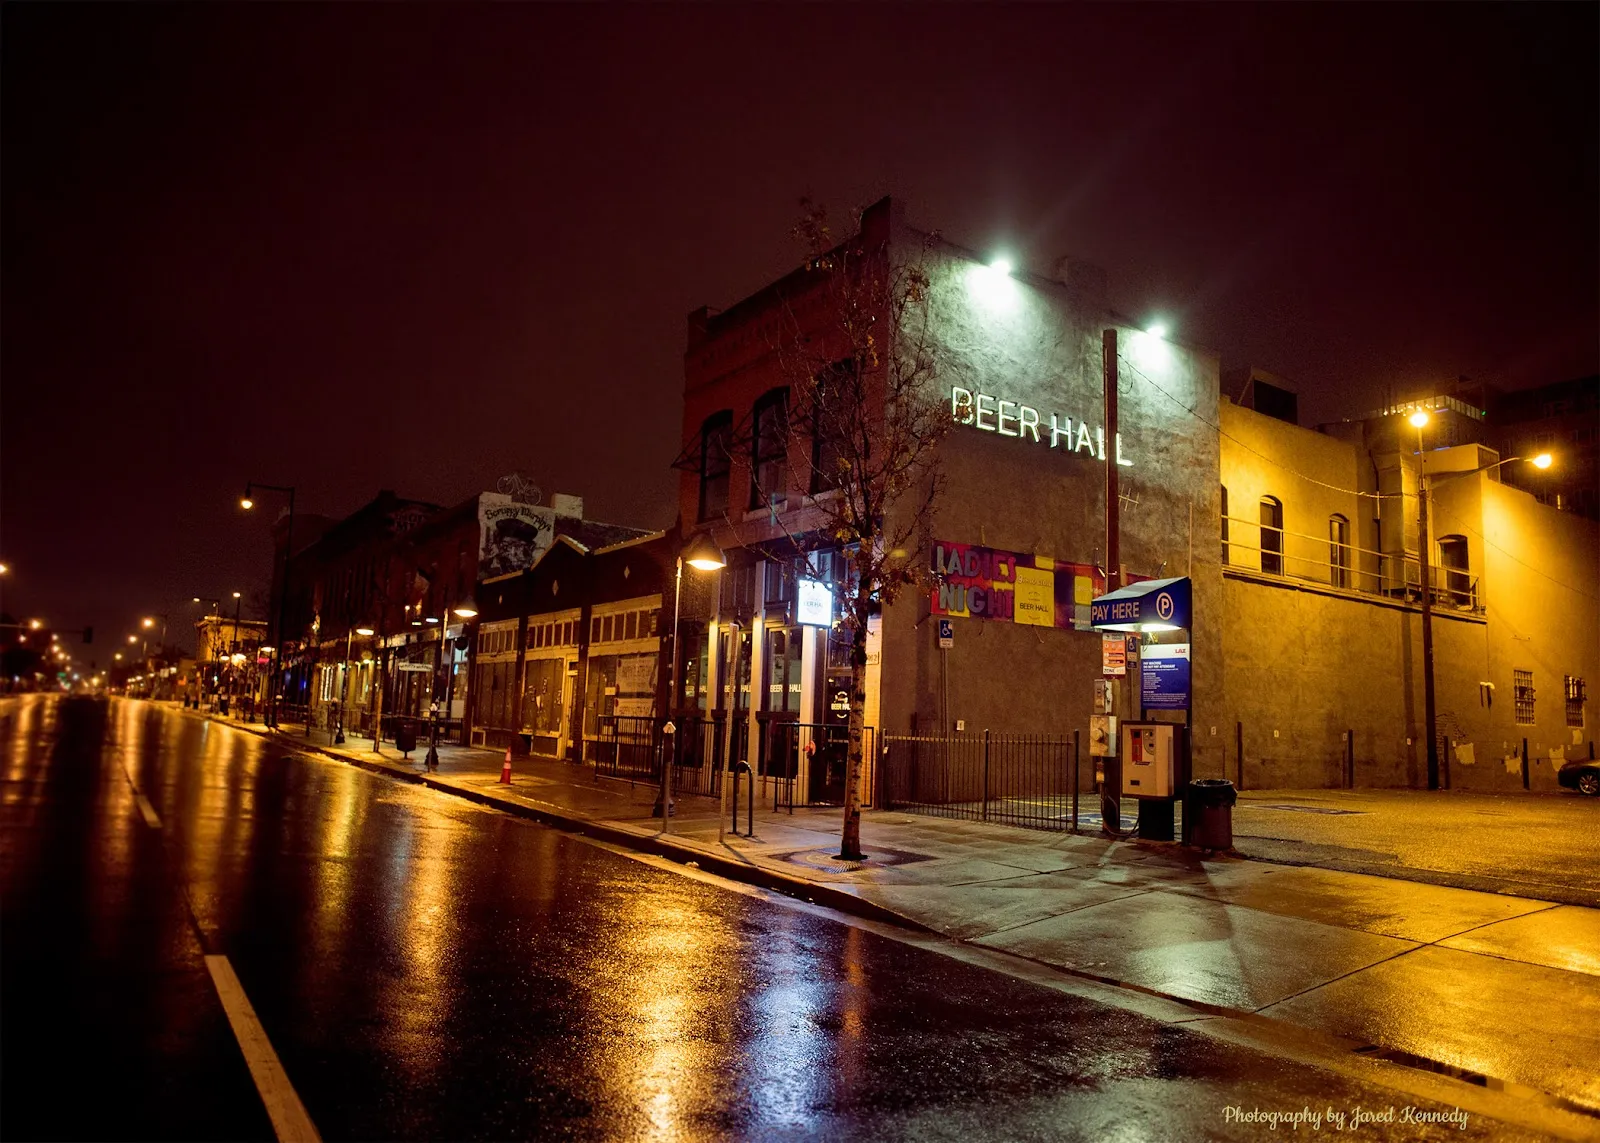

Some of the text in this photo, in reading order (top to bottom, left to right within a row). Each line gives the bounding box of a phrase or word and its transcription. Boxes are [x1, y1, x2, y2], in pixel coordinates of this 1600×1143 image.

[952, 386, 1135, 467] BEER HALL
[936, 545, 1017, 584] LADIES
[939, 582, 1015, 618] NIGHT
[1019, 602, 1049, 613] BEER HALL
[1161, 598, 1170, 614] P
[1091, 604, 1110, 621] PAY
[1111, 601, 1140, 619] HERE
[724, 684, 736, 693] BER
[770, 684, 802, 693] BEER HALL
[831, 703, 851, 711] BEER HAL
